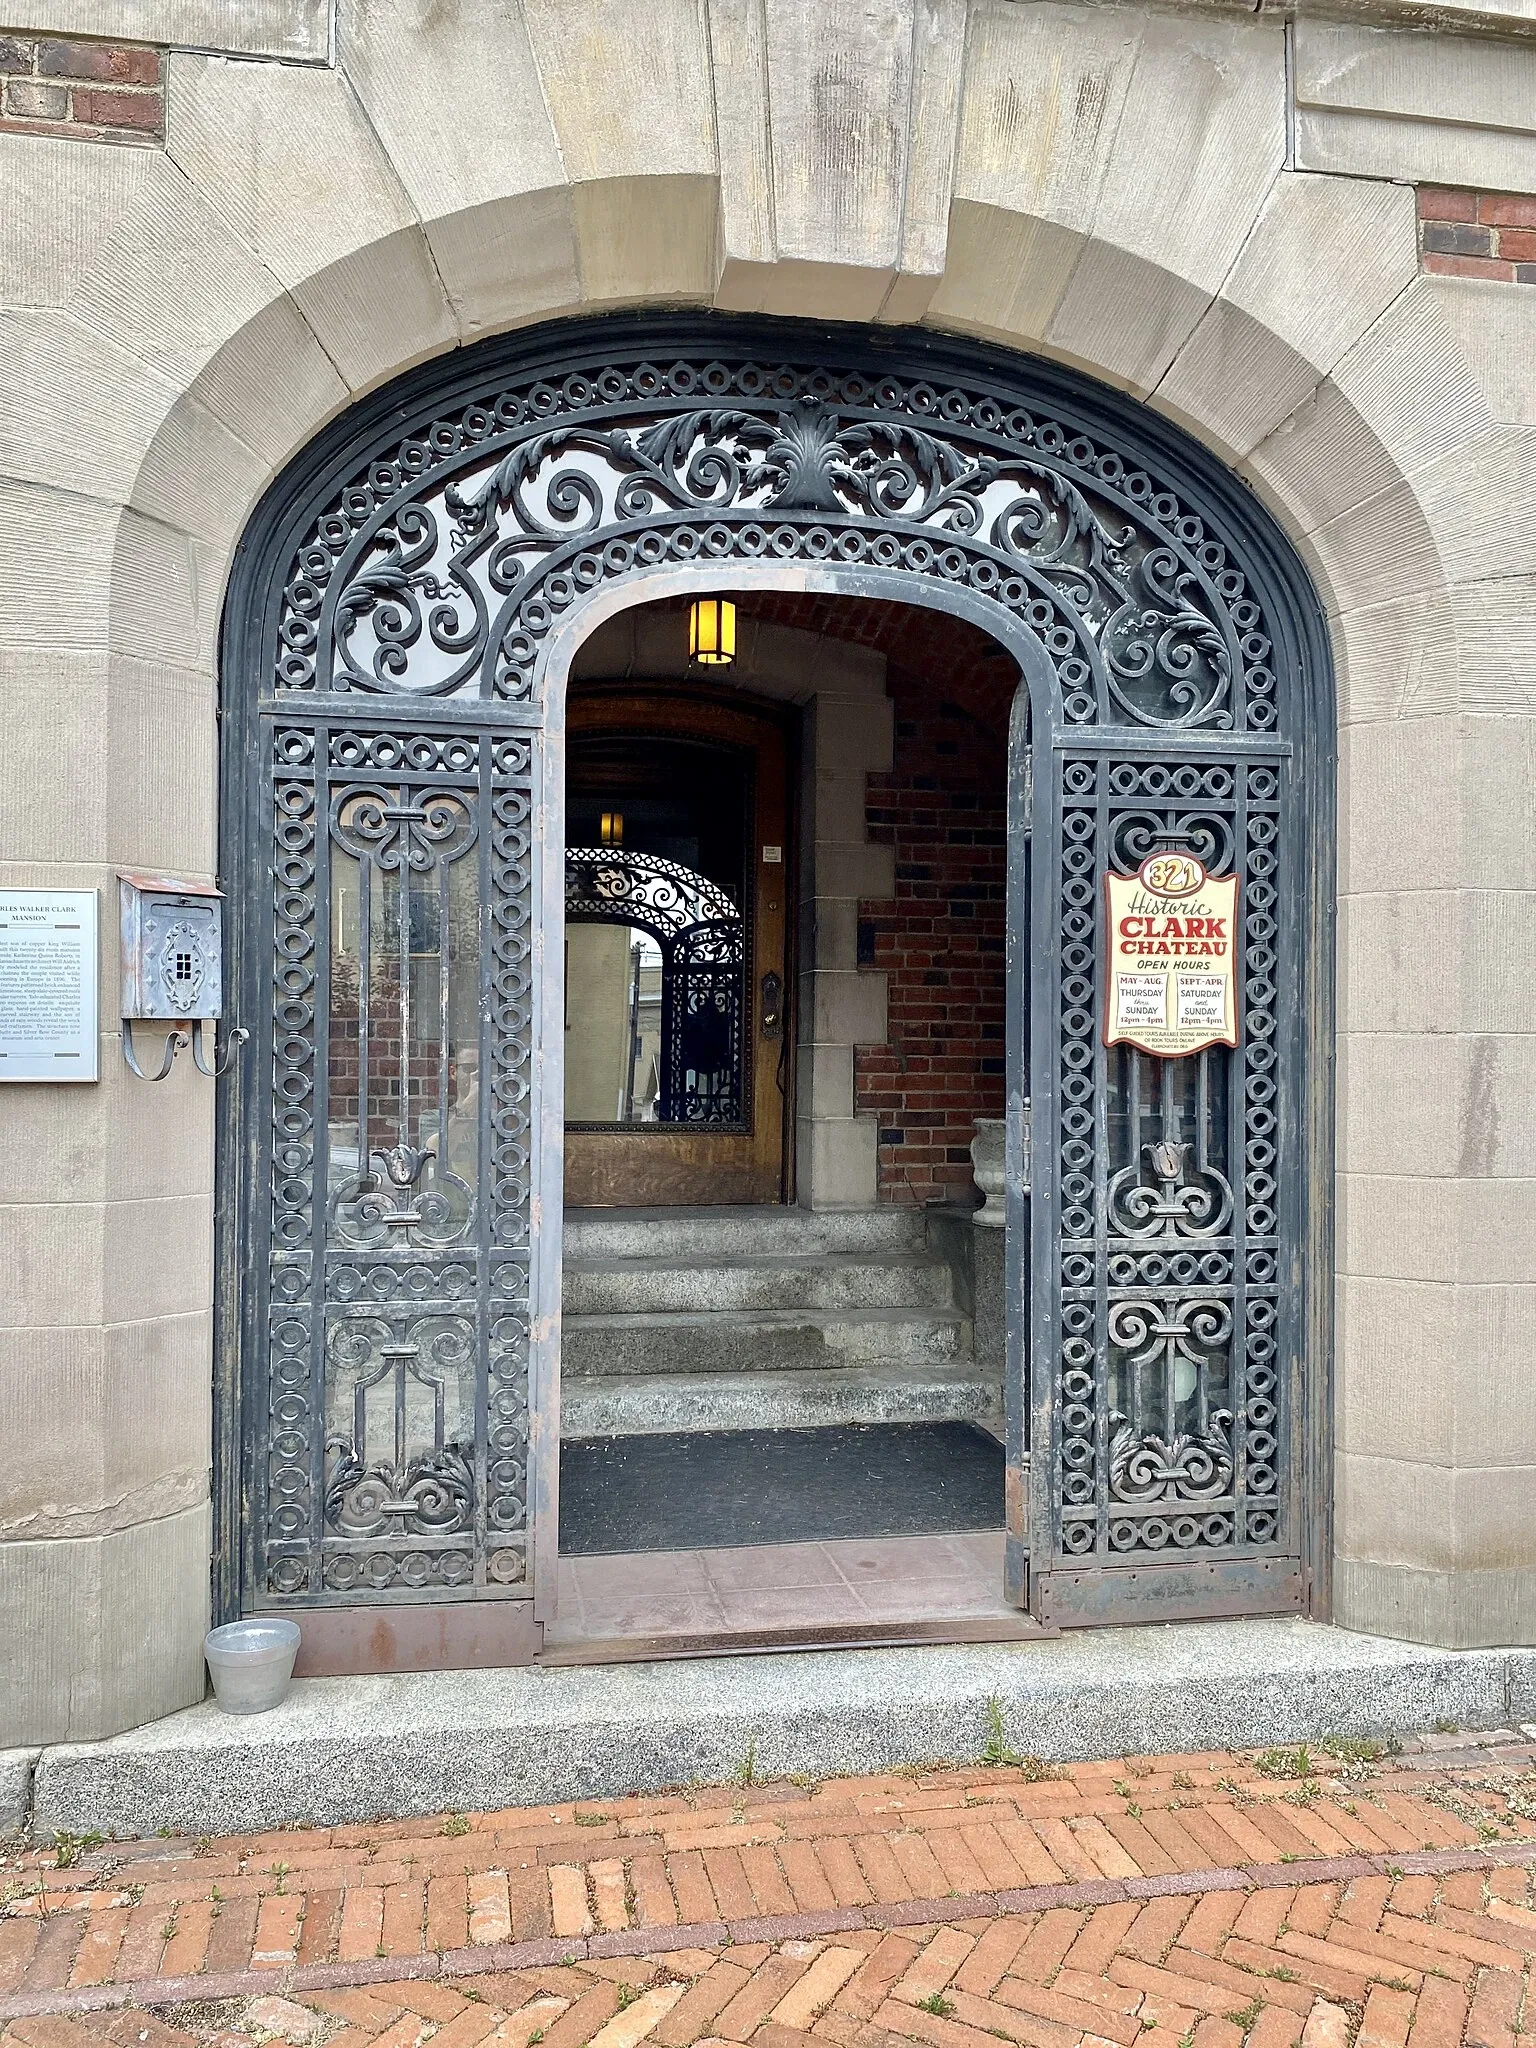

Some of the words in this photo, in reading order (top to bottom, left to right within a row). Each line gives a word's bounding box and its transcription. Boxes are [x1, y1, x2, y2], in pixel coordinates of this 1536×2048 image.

[1150, 858, 1199, 892] 321
[1128, 891, 1212, 915] Historic
[1120, 916, 1226, 938] CLARK
[1120, 941, 1227, 956] CHATEAU
[1137, 960, 1168, 970] OPEN
[1173, 961, 1211, 970] HOURS
[1120, 988, 1163, 996] THURSDAY
[1180, 989, 1222, 997] SATURDAY
[1125, 1006, 1158, 1014] SUNDAY
[1184, 1007, 1217, 1015] SUNDAY
